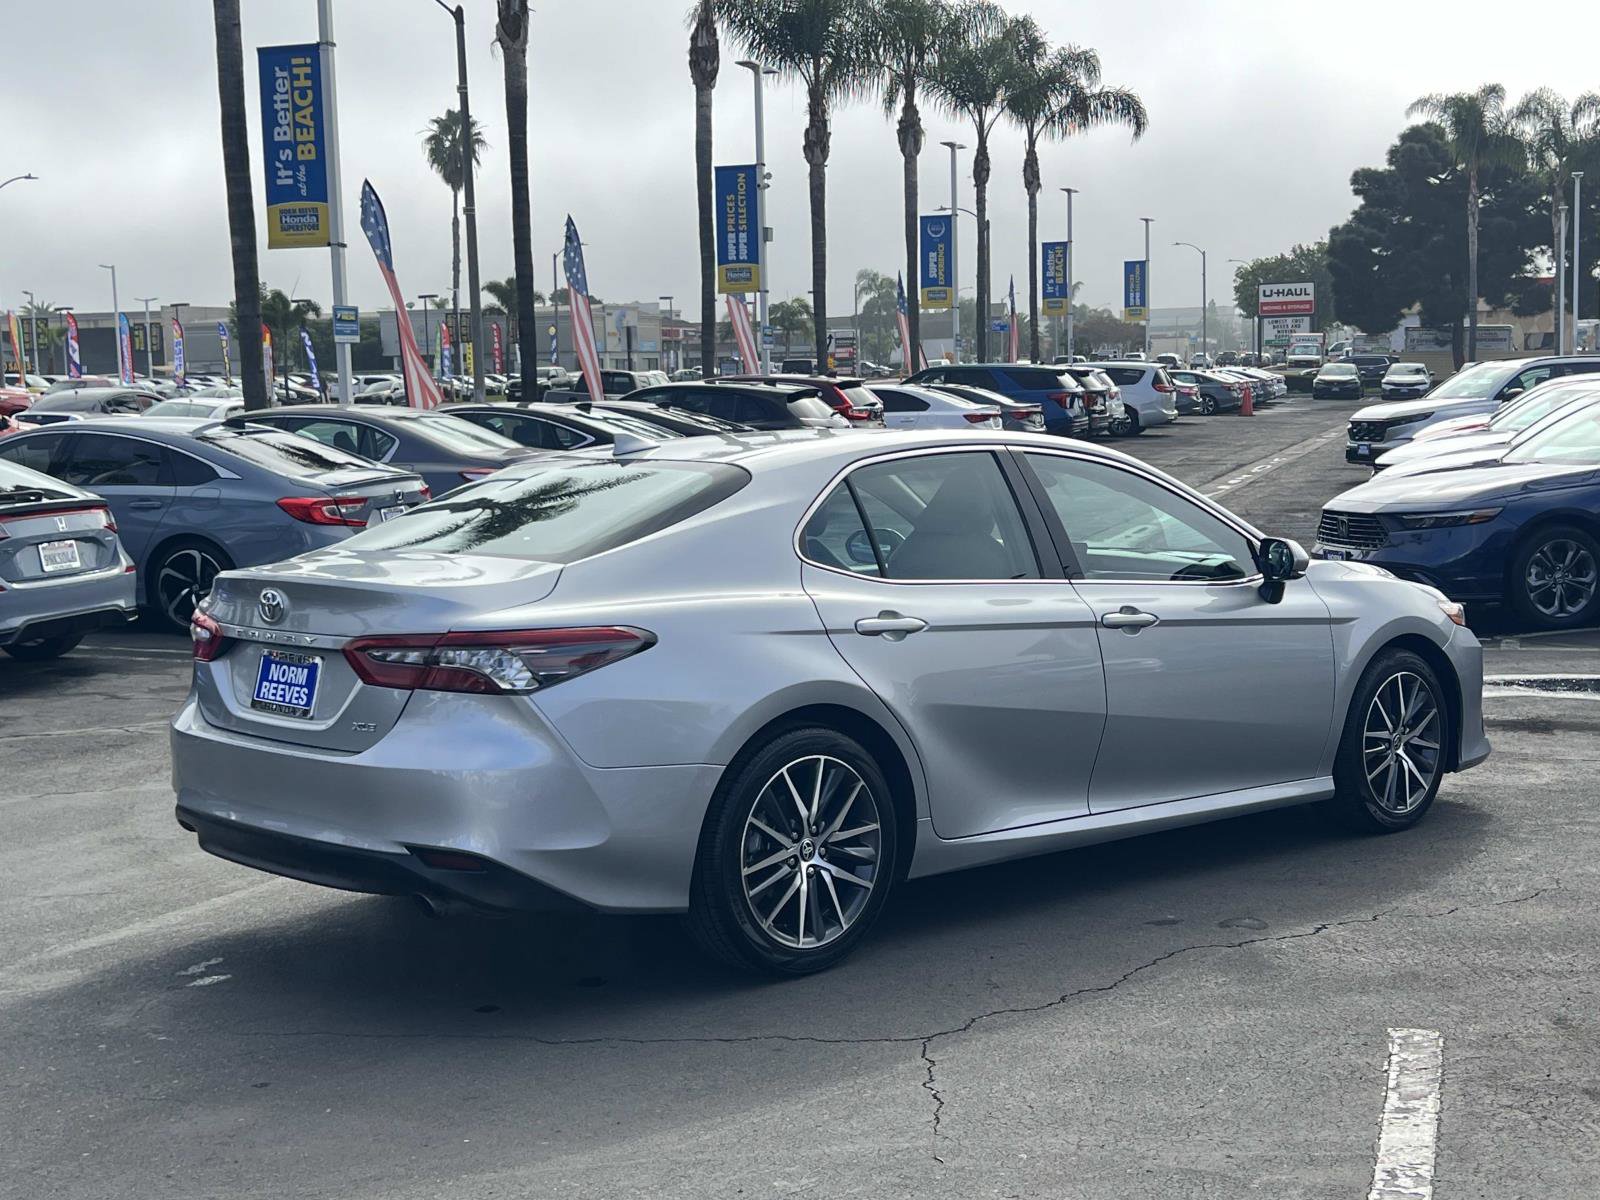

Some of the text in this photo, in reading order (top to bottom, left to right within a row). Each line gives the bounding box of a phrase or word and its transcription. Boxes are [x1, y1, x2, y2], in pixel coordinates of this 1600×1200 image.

[290, 56, 317, 161] BEACH!
[272, 66, 293, 185] It's Better
[281, 214, 318, 224] Honda
[726, 193, 737, 261] SUPER PRICES
[736, 173, 748, 260] SUPER SELECTION
[928, 251, 938, 279] SUPER
[1262, 287, 1311, 298] U-HAUL
[269, 663, 308, 685] NORM
[259, 681, 308, 706] REEVES
